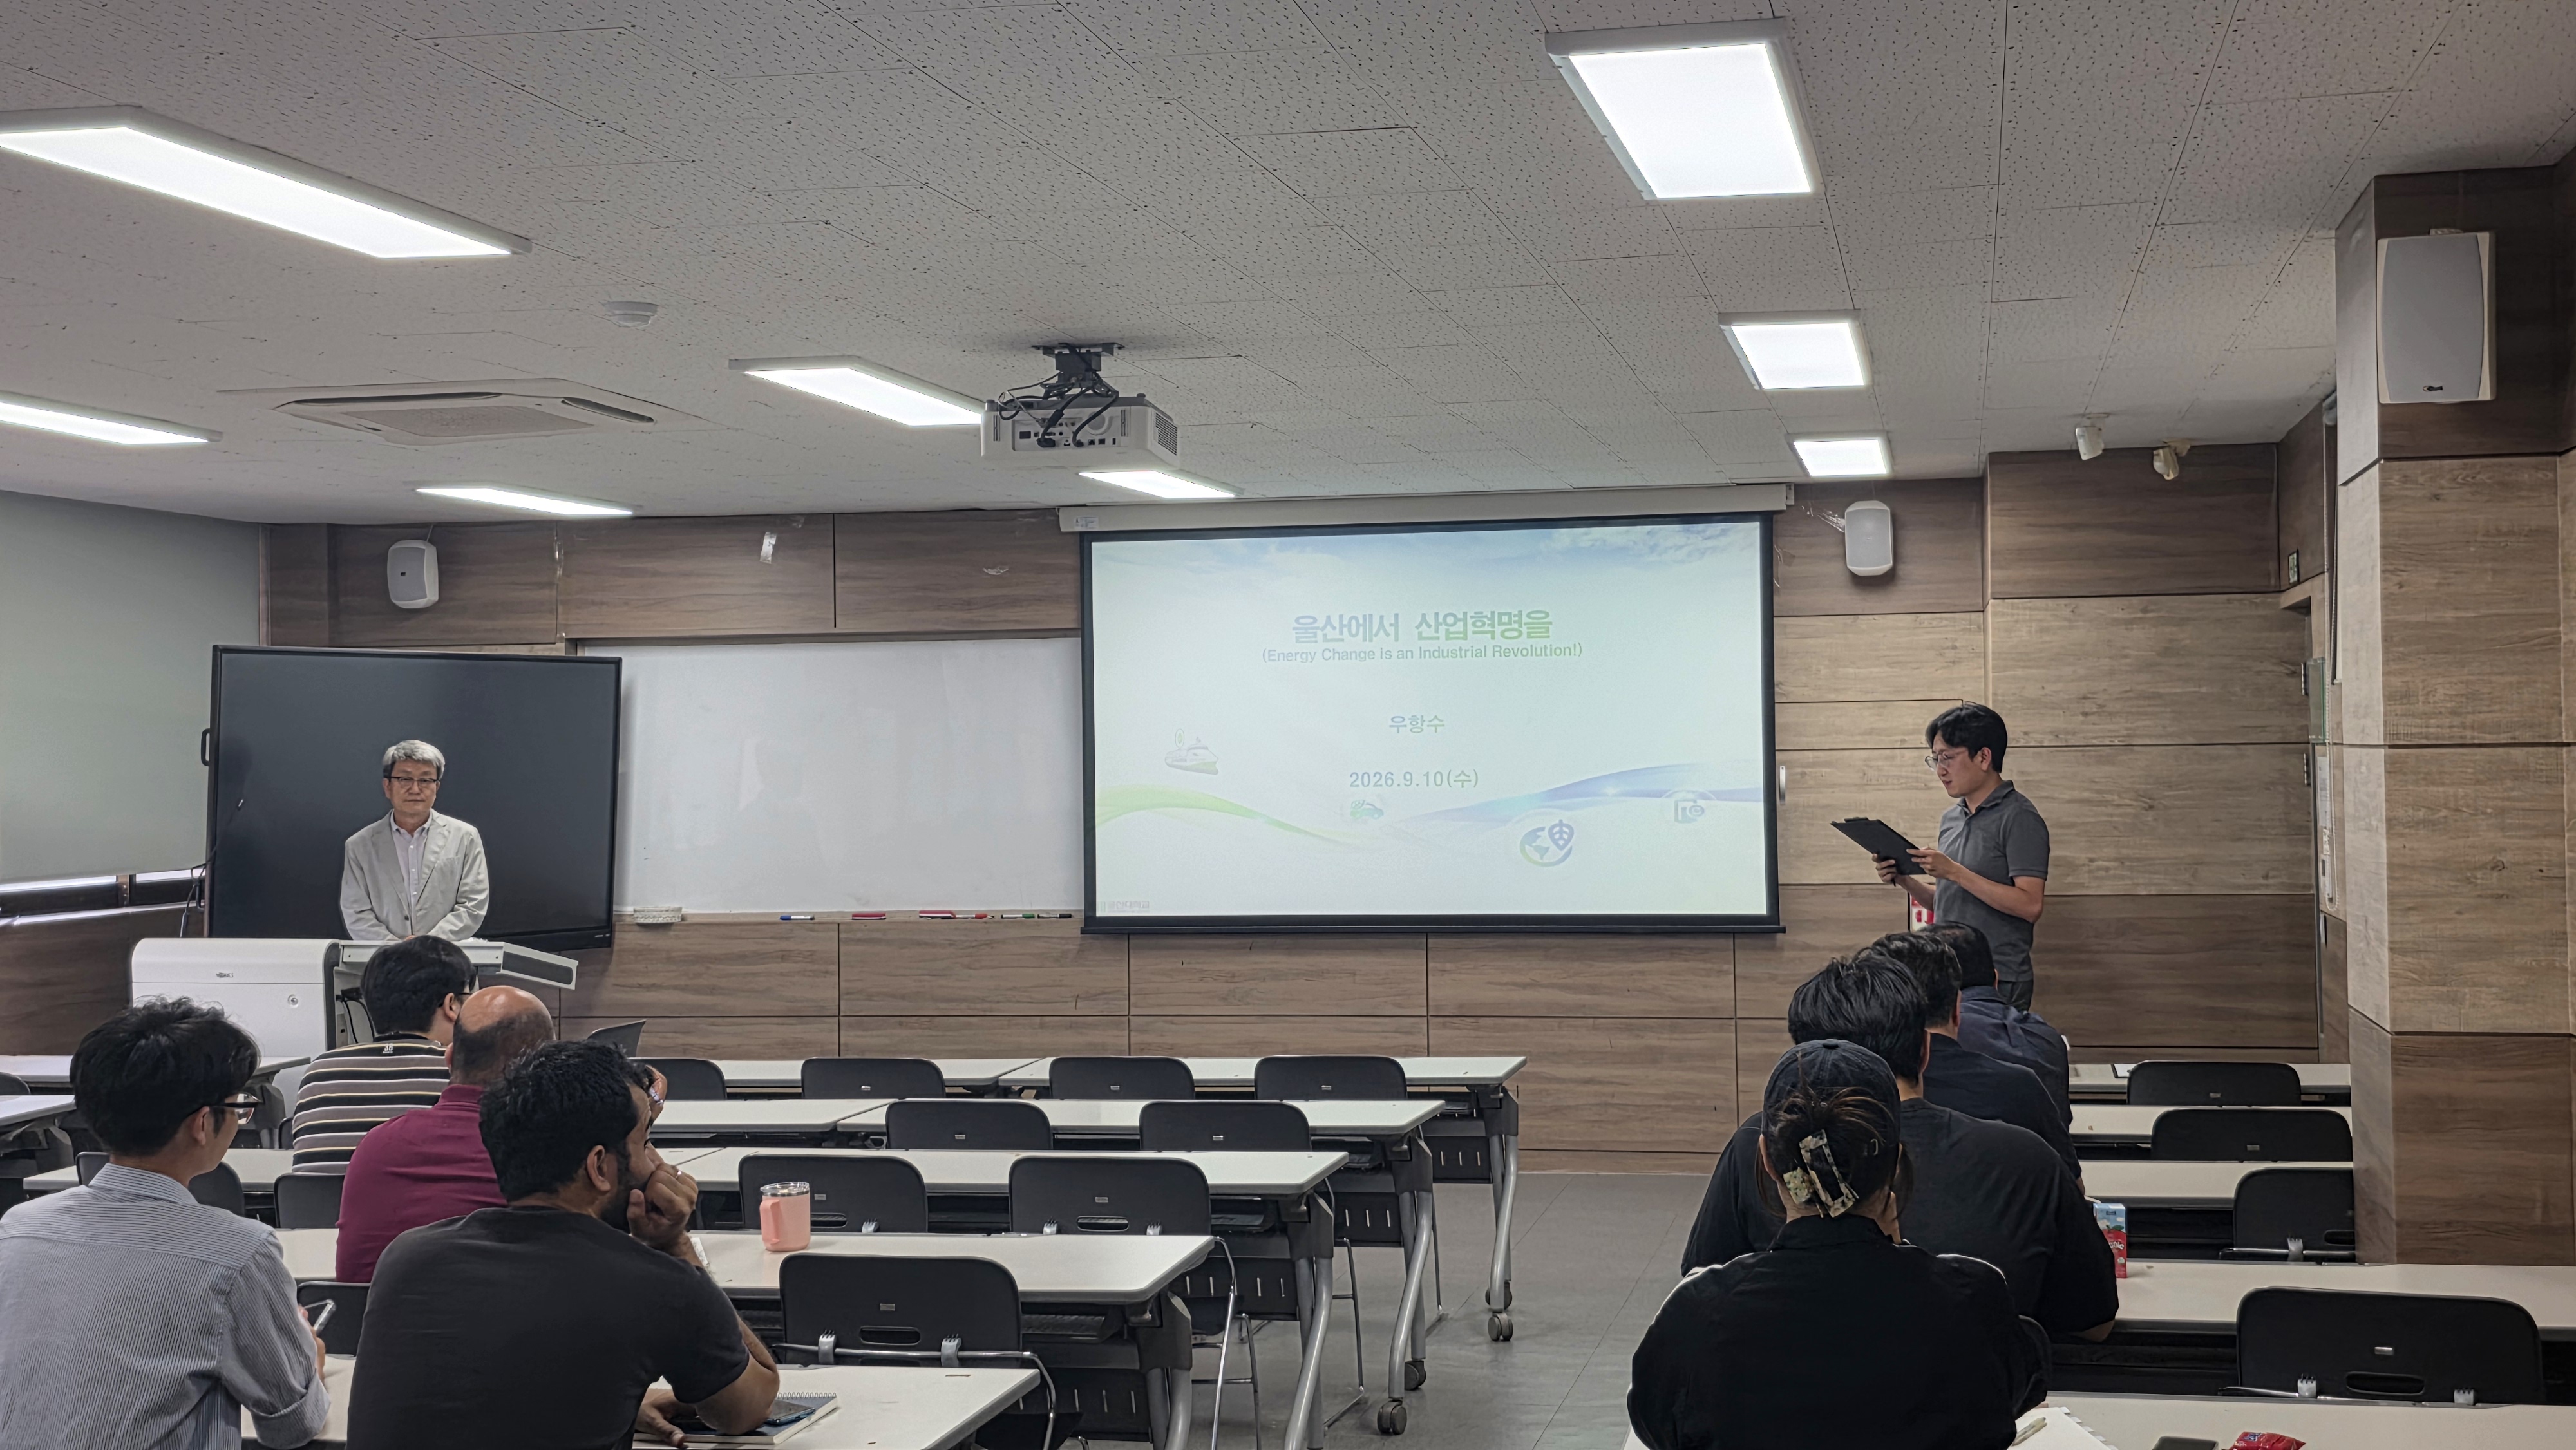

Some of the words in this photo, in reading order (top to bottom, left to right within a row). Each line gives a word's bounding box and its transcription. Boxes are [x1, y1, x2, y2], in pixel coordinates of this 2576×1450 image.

[1292, 613, 1399, 643] 울산에서
[1415, 610, 1553, 641] 산업혁명을
[1262, 648, 1317, 663] (Energy
[1321, 648, 1376, 661] Change
[1380, 647, 1392, 659] is
[1397, 649, 1414, 659] an
[1419, 645, 1486, 659] Industrial
[1492, 642, 1582, 657] Revolution!)
[1389, 715, 1444, 734] 우항수
[1349, 769, 1479, 788] 2026.9.10(수)
